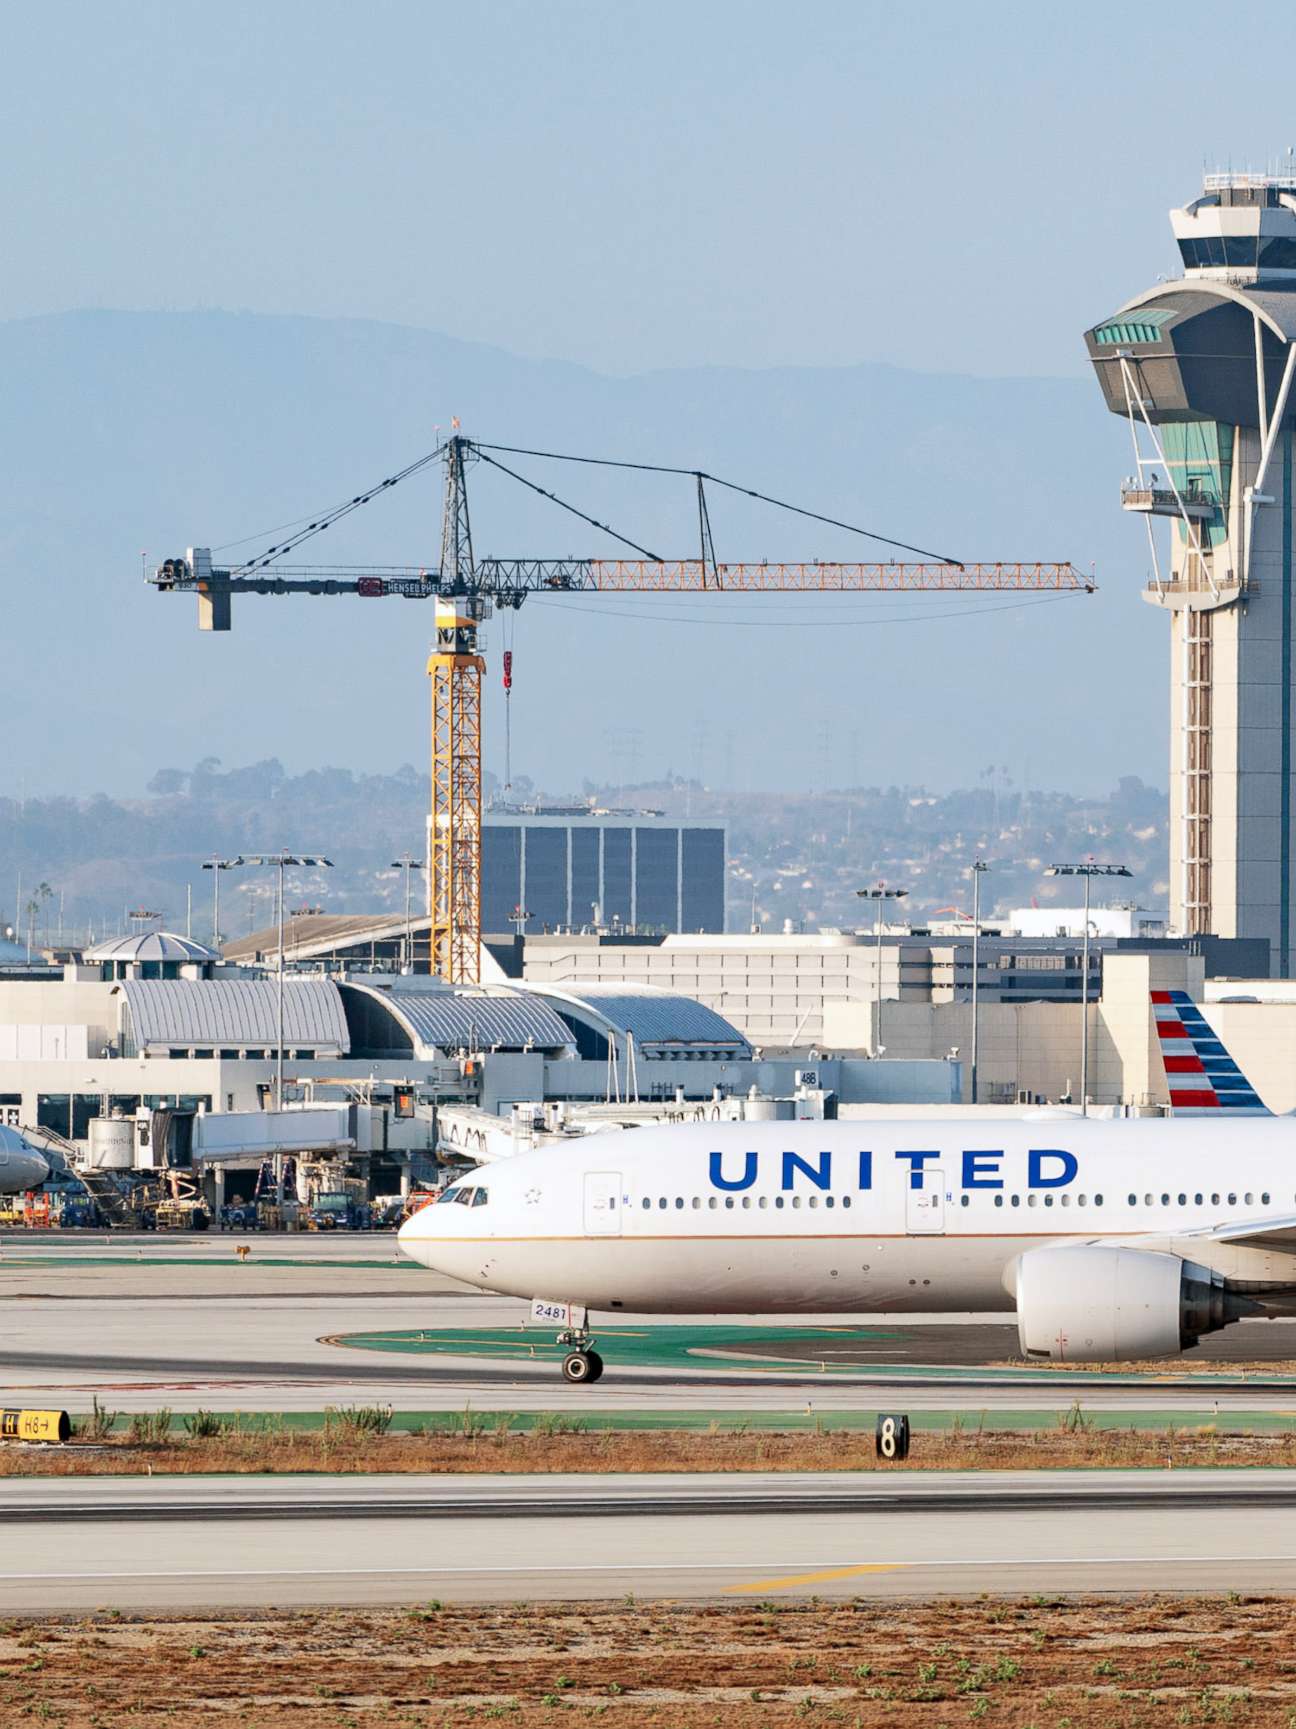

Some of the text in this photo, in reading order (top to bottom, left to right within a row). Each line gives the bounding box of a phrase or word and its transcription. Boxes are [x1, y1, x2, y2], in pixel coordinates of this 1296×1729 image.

[388, 583, 451, 593] HENSEL PHELPS
[709, 1149, 1079, 1192] UNITED
[535, 1304, 566, 1319] 2481
[5, 1414, 39, 1434] H H8
[881, 1417, 896, 1458] 8
